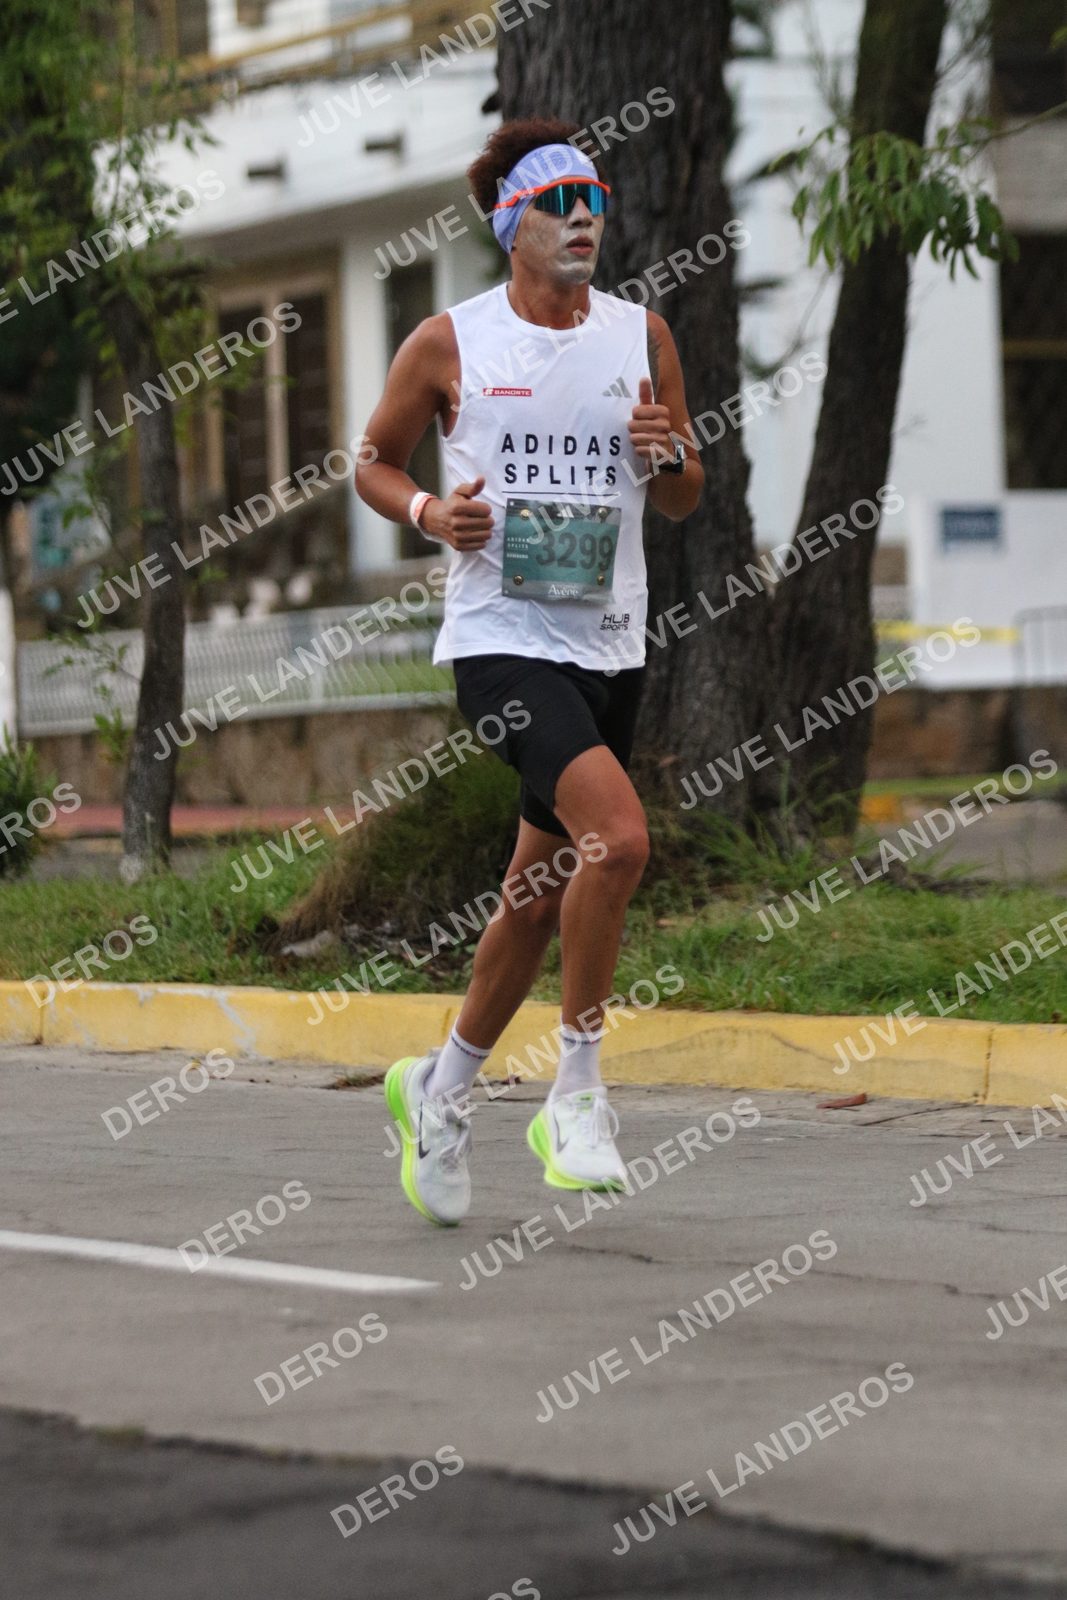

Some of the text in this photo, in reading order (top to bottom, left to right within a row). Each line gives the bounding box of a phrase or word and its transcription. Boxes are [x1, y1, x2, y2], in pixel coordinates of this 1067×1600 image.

[502, 433, 621, 456] ADIDAS
[504, 463, 616, 486] SPLITS
[535, 531, 614, 572] 3299
[602, 613, 630, 624] HUB
